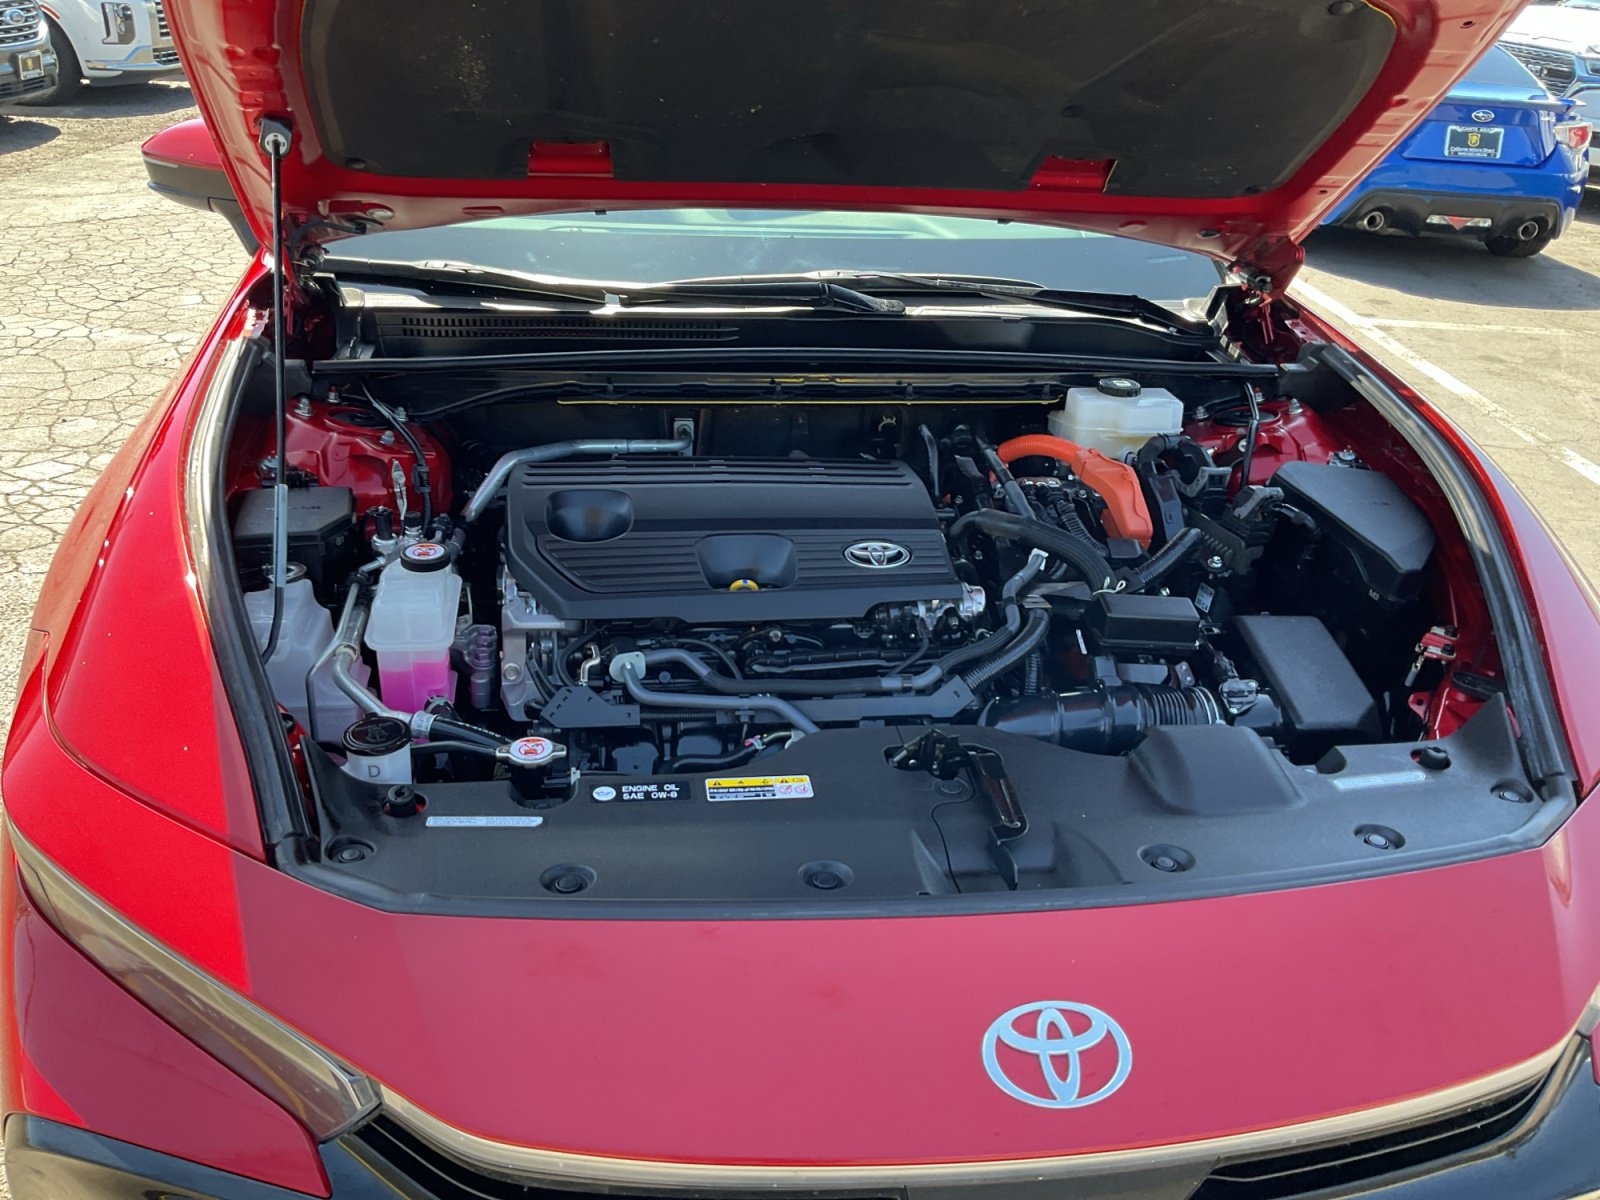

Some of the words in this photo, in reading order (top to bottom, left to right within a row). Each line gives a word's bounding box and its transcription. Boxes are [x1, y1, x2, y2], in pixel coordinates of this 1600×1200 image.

[368, 765, 380, 778] D
[622, 784, 658, 793] ENGINE
[663, 783, 680, 792] OIL
[622, 792, 645, 800] SAE
